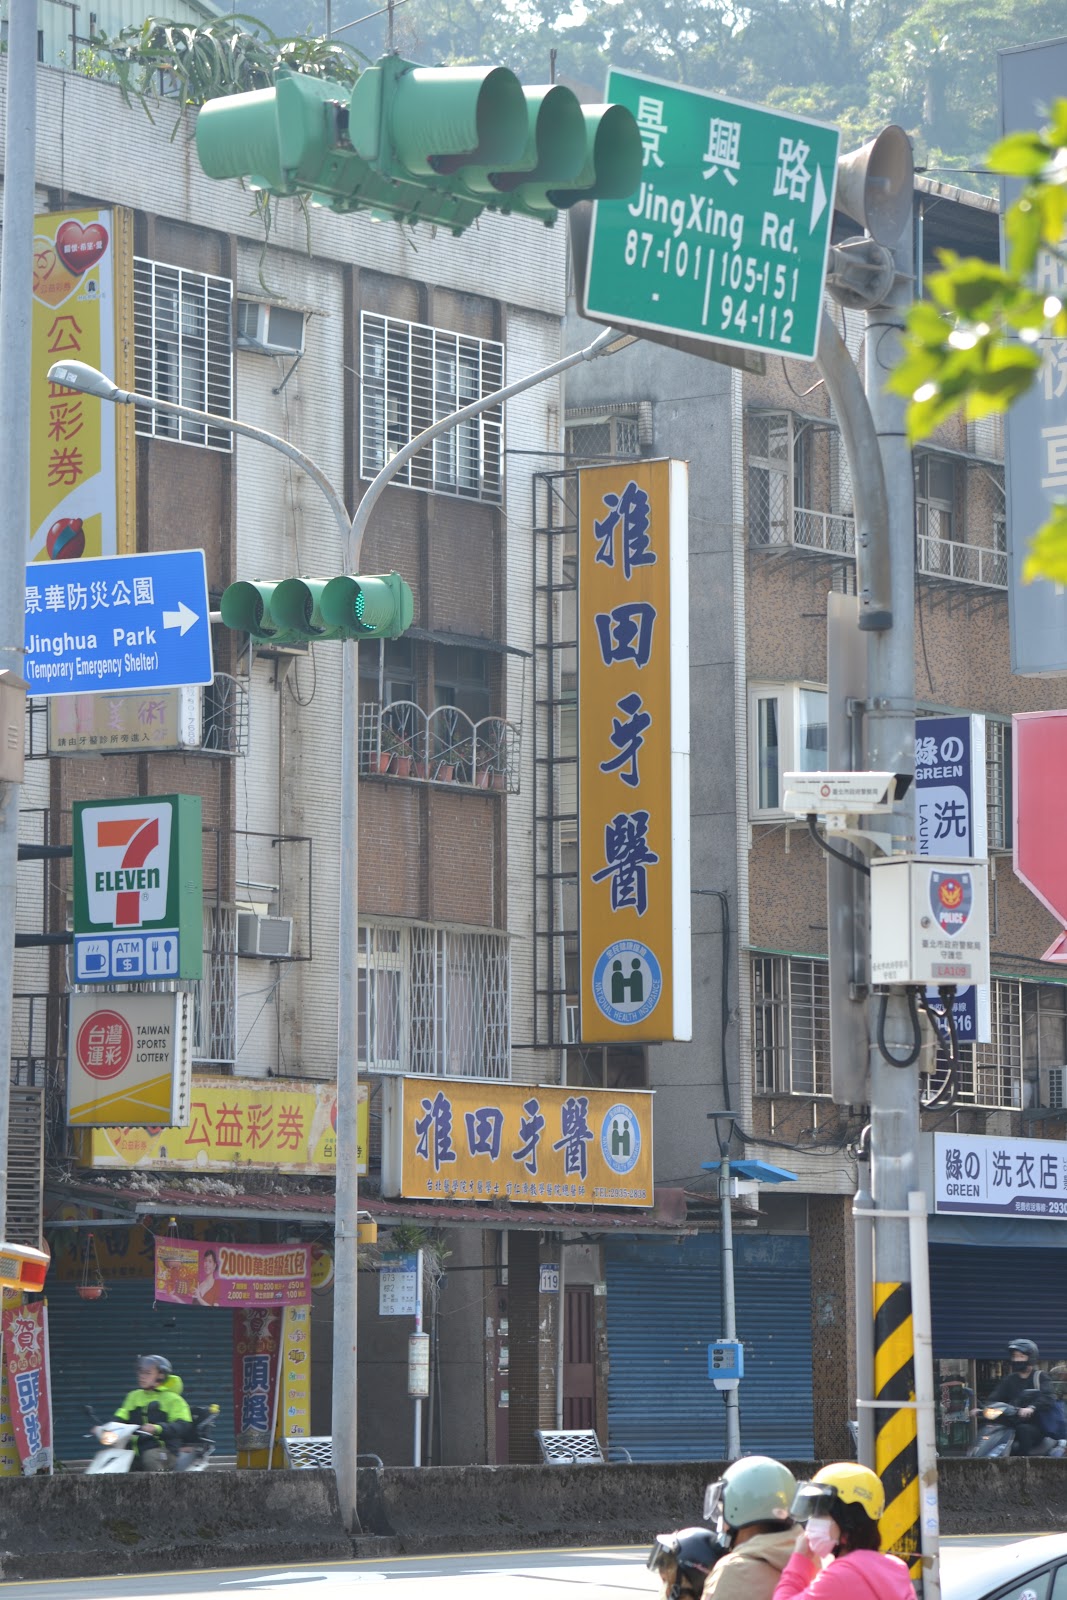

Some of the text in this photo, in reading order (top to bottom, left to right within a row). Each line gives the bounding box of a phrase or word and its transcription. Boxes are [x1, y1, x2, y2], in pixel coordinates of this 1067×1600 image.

[636, 95, 812, 203] 景興路
[627, 181, 798, 255] JingXing Rd.
[624, 229, 702, 281] 87-101
[720, 251, 799, 303] 105-151
[720, 295, 793, 344] 94-112
[24, 576, 155, 615] 景華防災公園
[25, 626, 156, 656] Jinghua Park
[26, 651, 159, 682] (Temporary Emergency Shelter)
[915, 765, 963, 780] GREEN
[919, 804, 929, 855] LAUN
[940, 911, 964, 924] POLICE
[116, 942, 140, 954] ATM
[136, 1025, 170, 1035] TAIWAN
[136, 1039, 167, 1049] SPORTS
[136, 1053, 169, 1062] LOTTERY
[184, 1102, 304, 1150] 公益彩券
[992, 1150, 1058, 1190] 洗衣店
[946, 1183, 980, 1197] GREEN
[543, 1275, 558, 1289] 119
[242, 1354, 271, 1432] 頭獎
